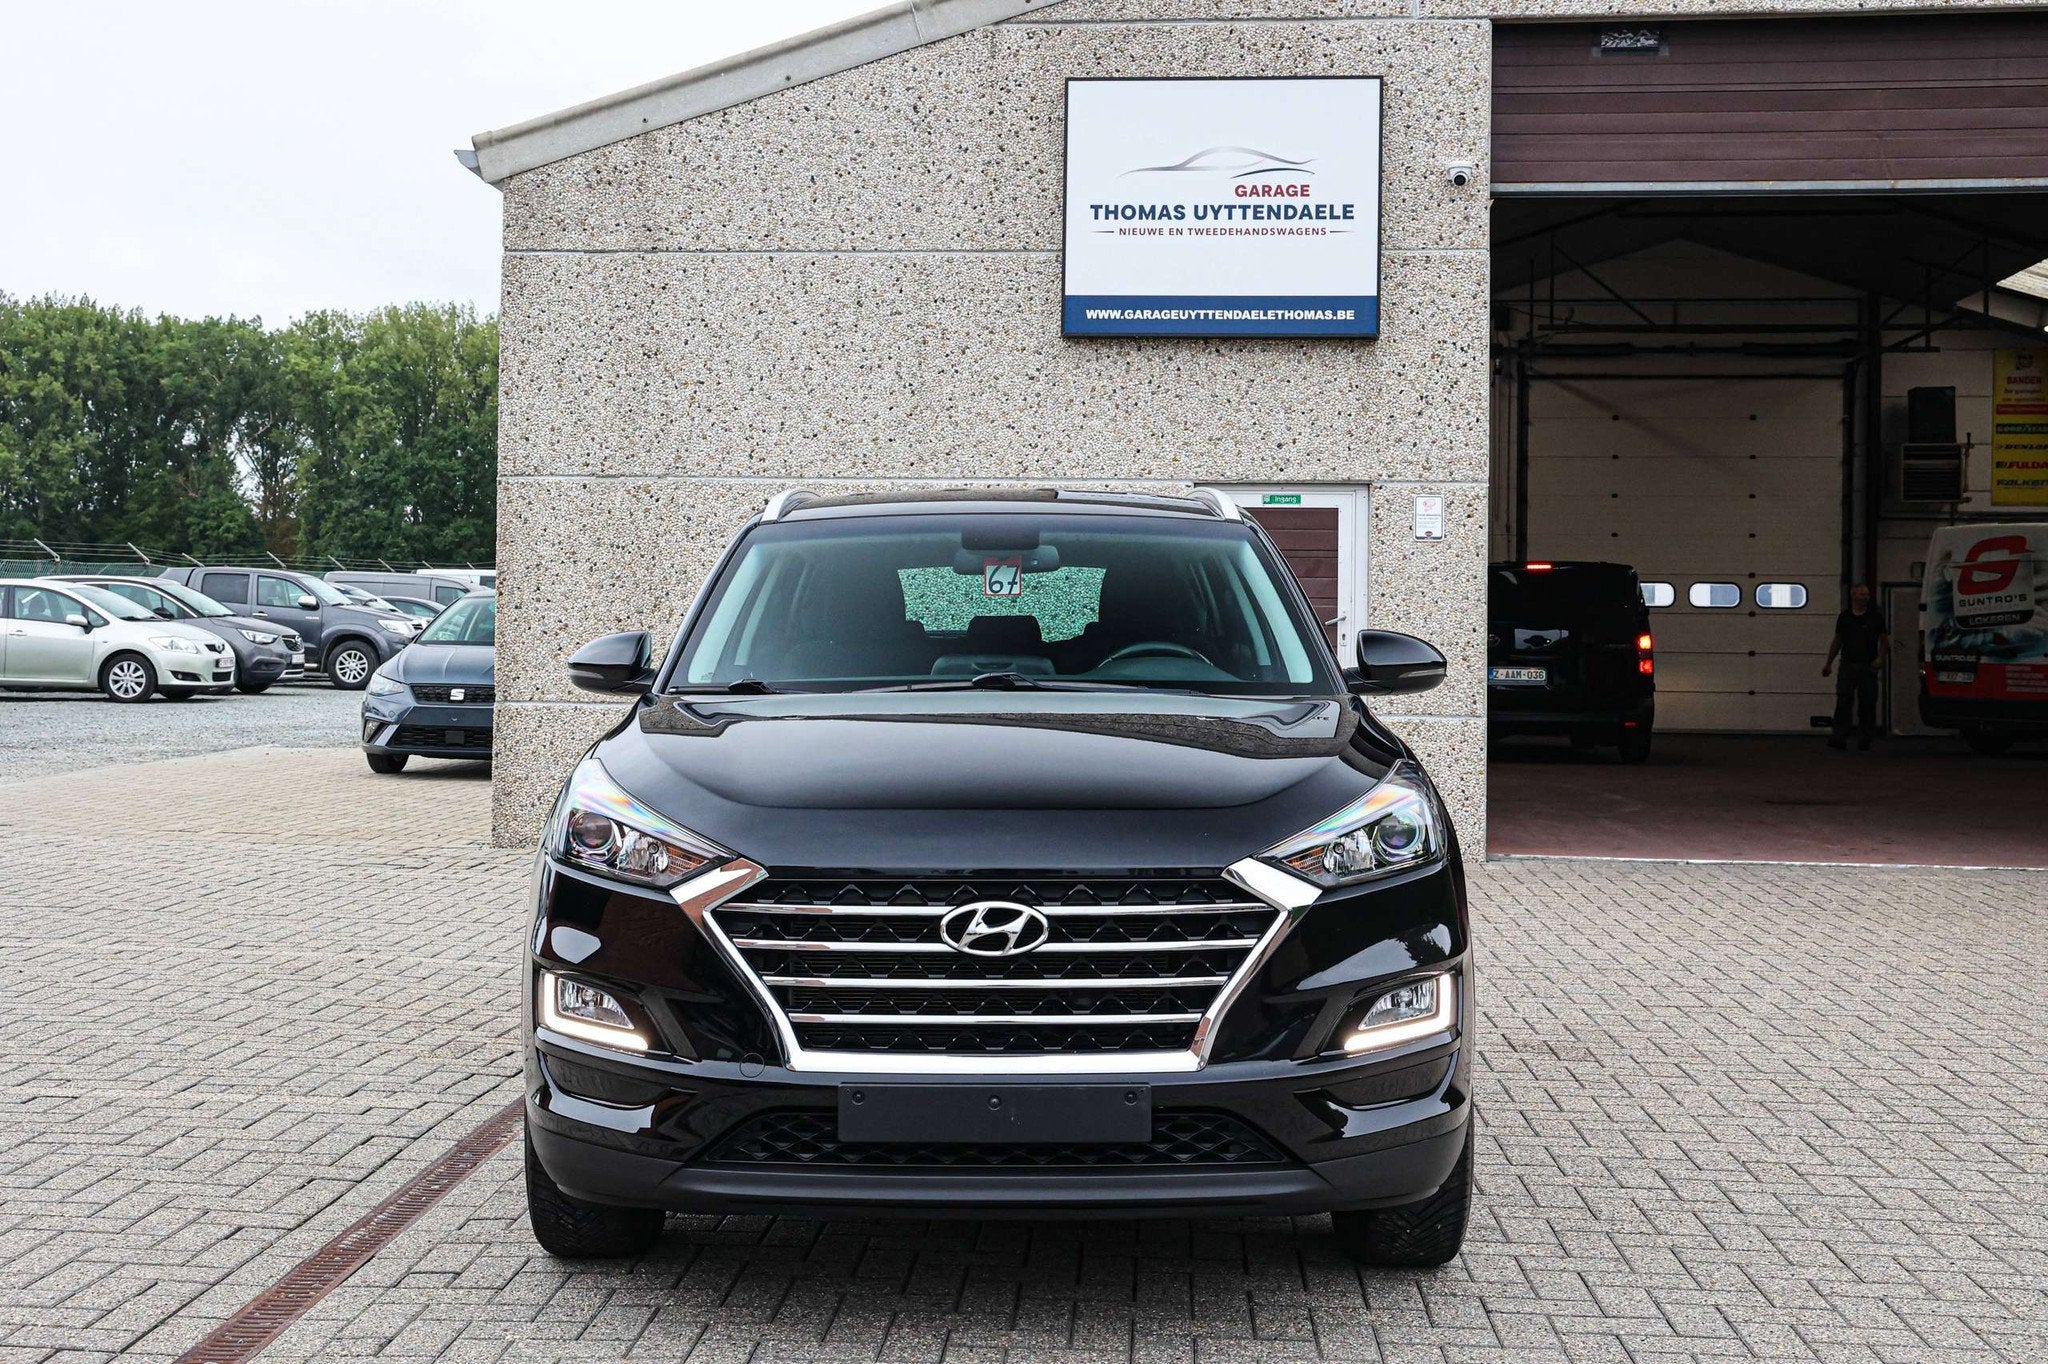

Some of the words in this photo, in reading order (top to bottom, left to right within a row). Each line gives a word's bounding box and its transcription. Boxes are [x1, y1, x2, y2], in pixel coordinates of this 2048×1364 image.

[1234, 184, 1311, 198] GARAGE
[1090, 204, 1186, 221] THOMAS
[1193, 204, 1355, 221] UYTTENDAELE
[1118, 227, 1164, 236] NIEUWE
[1168, 227, 1184, 236] EN
[1187, 227, 1328, 236] TWEEDEHANDSWAGENS
[1085, 309, 1354, 320] WWW.GARAGEUYTTENDAELETHOMAS.BE
[1274, 494, 1297, 504] Ingang
[1959, 594, 2027, 607] GUNTRO'S
